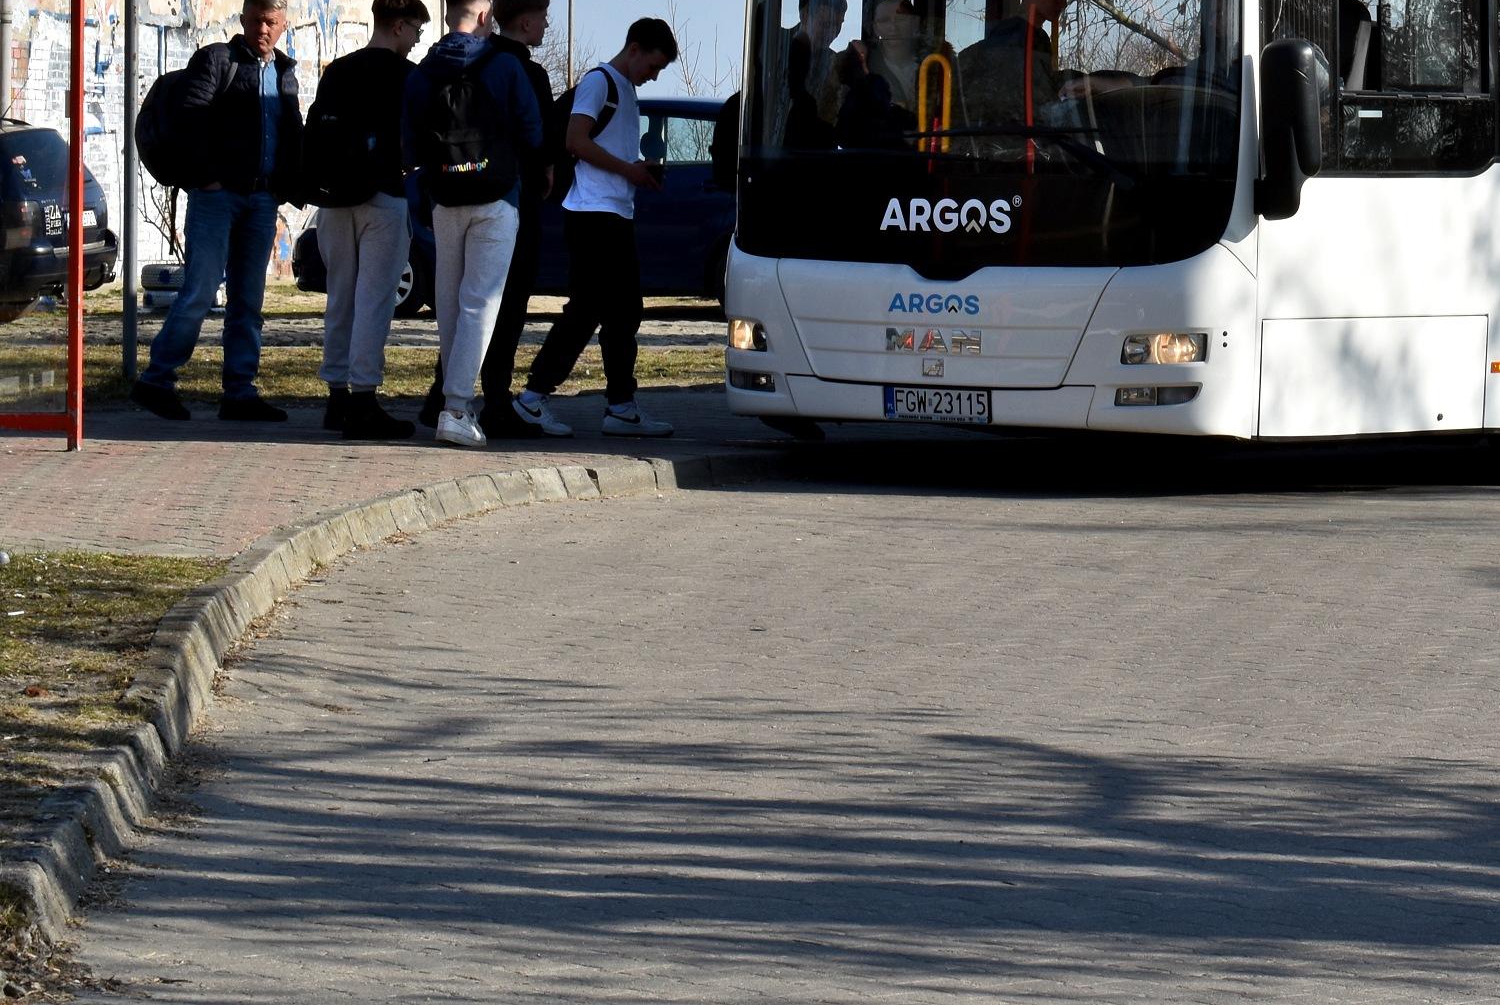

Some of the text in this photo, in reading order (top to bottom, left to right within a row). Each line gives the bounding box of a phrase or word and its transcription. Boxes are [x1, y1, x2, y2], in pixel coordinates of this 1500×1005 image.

[888, 293, 980, 315] ARGOS
[885, 327, 982, 355] MAN
[895, 389, 986, 416] FGW 23115
